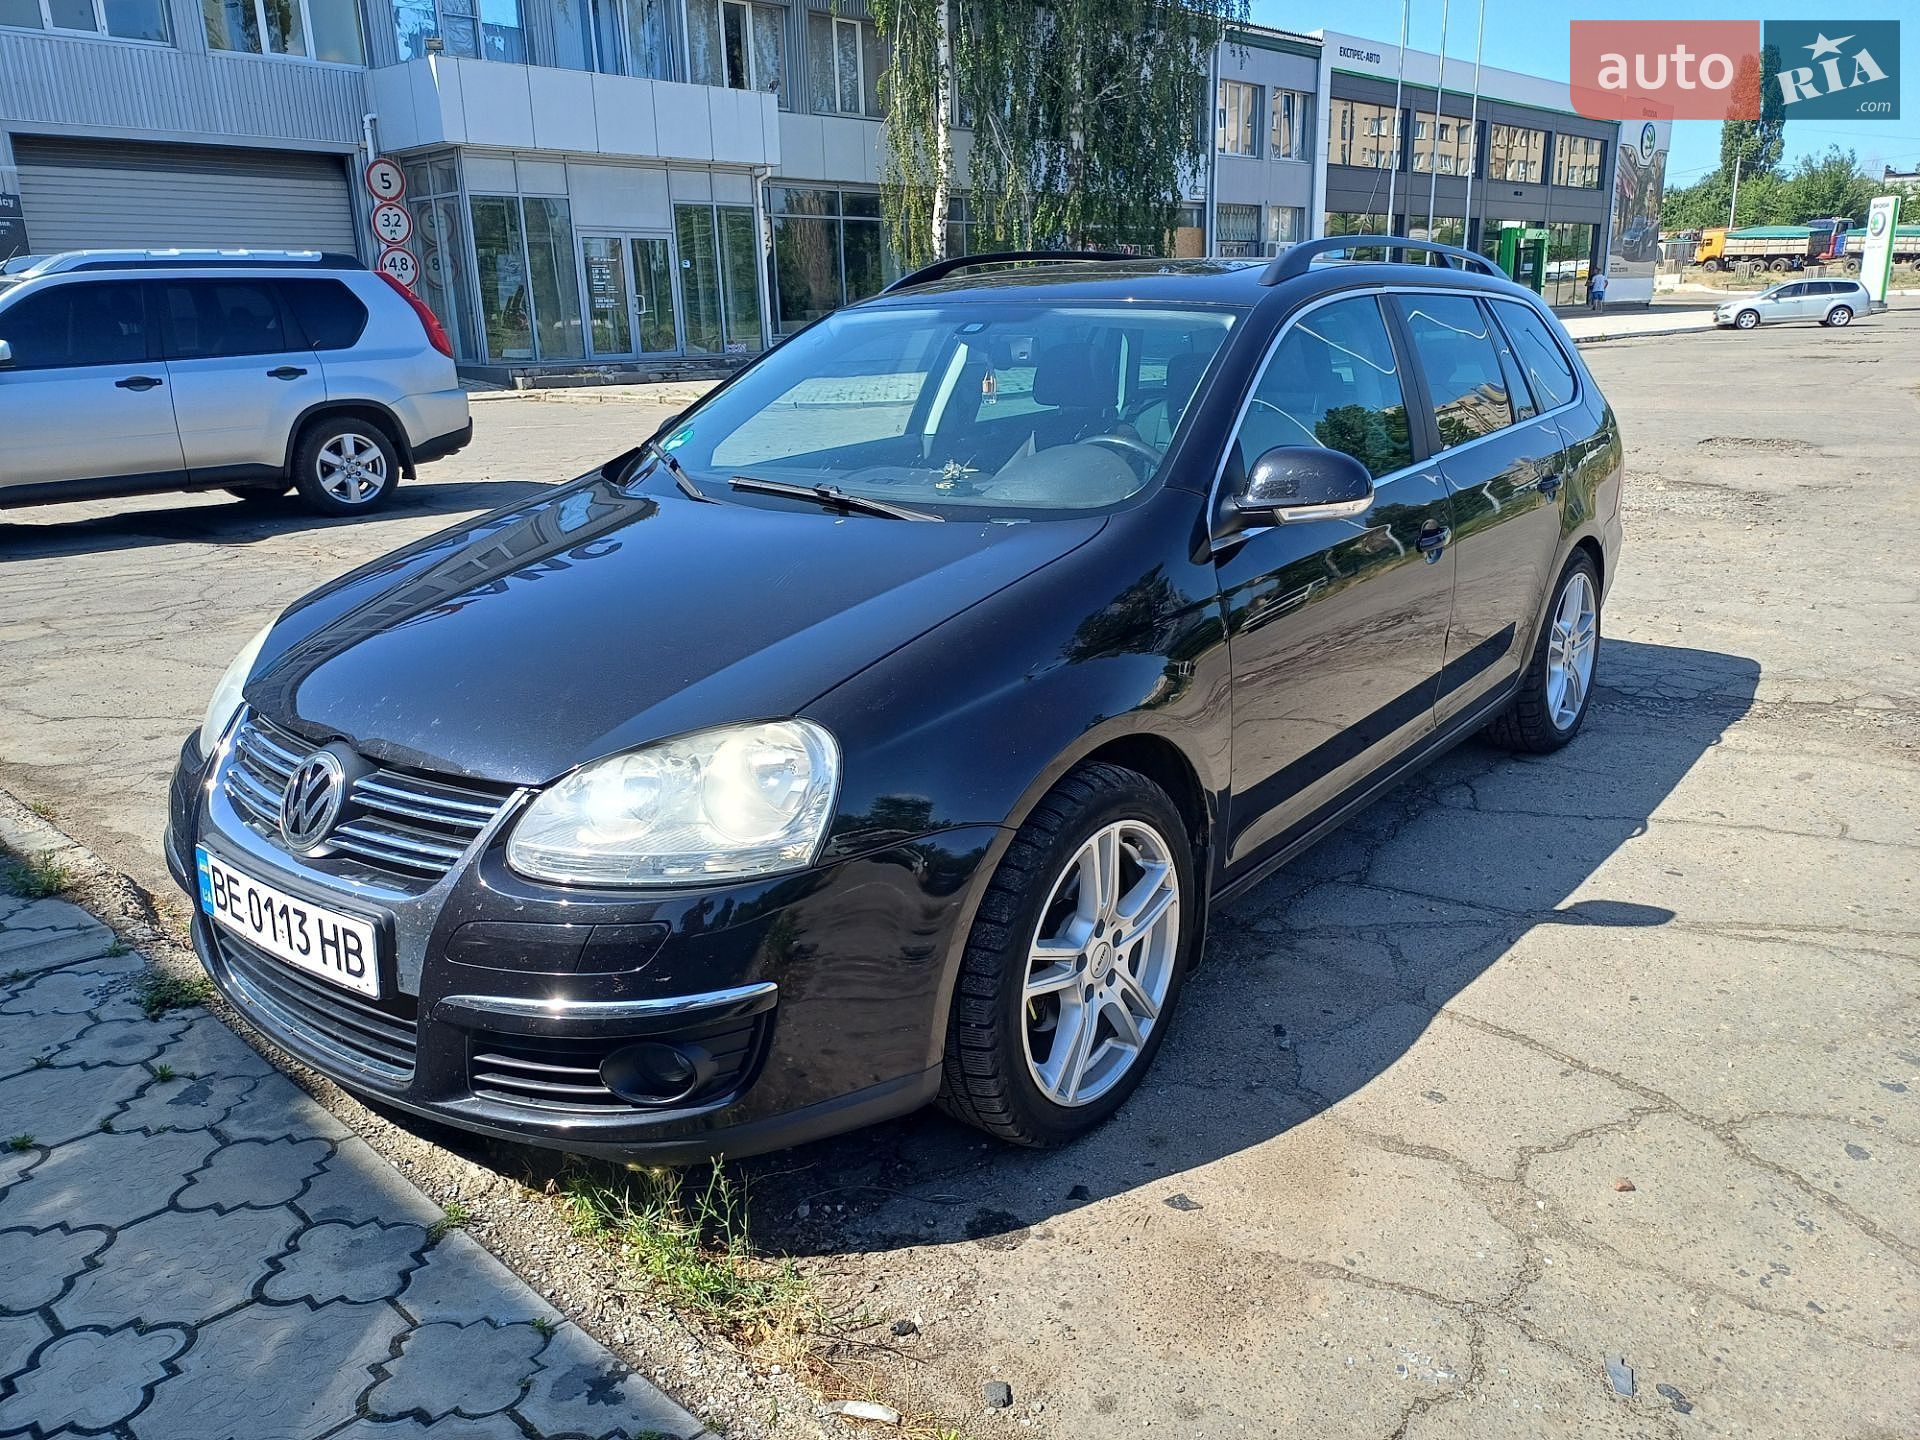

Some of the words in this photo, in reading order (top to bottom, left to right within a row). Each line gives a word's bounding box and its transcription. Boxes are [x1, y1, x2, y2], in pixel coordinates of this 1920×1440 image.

[380, 173, 392, 190] 5
[381, 213, 402, 228] 3.2
[388, 257, 409, 271] 4.8
[211, 864, 245, 924] BE
[248, 887, 311, 956] 0113
[317, 917, 366, 978] HB
